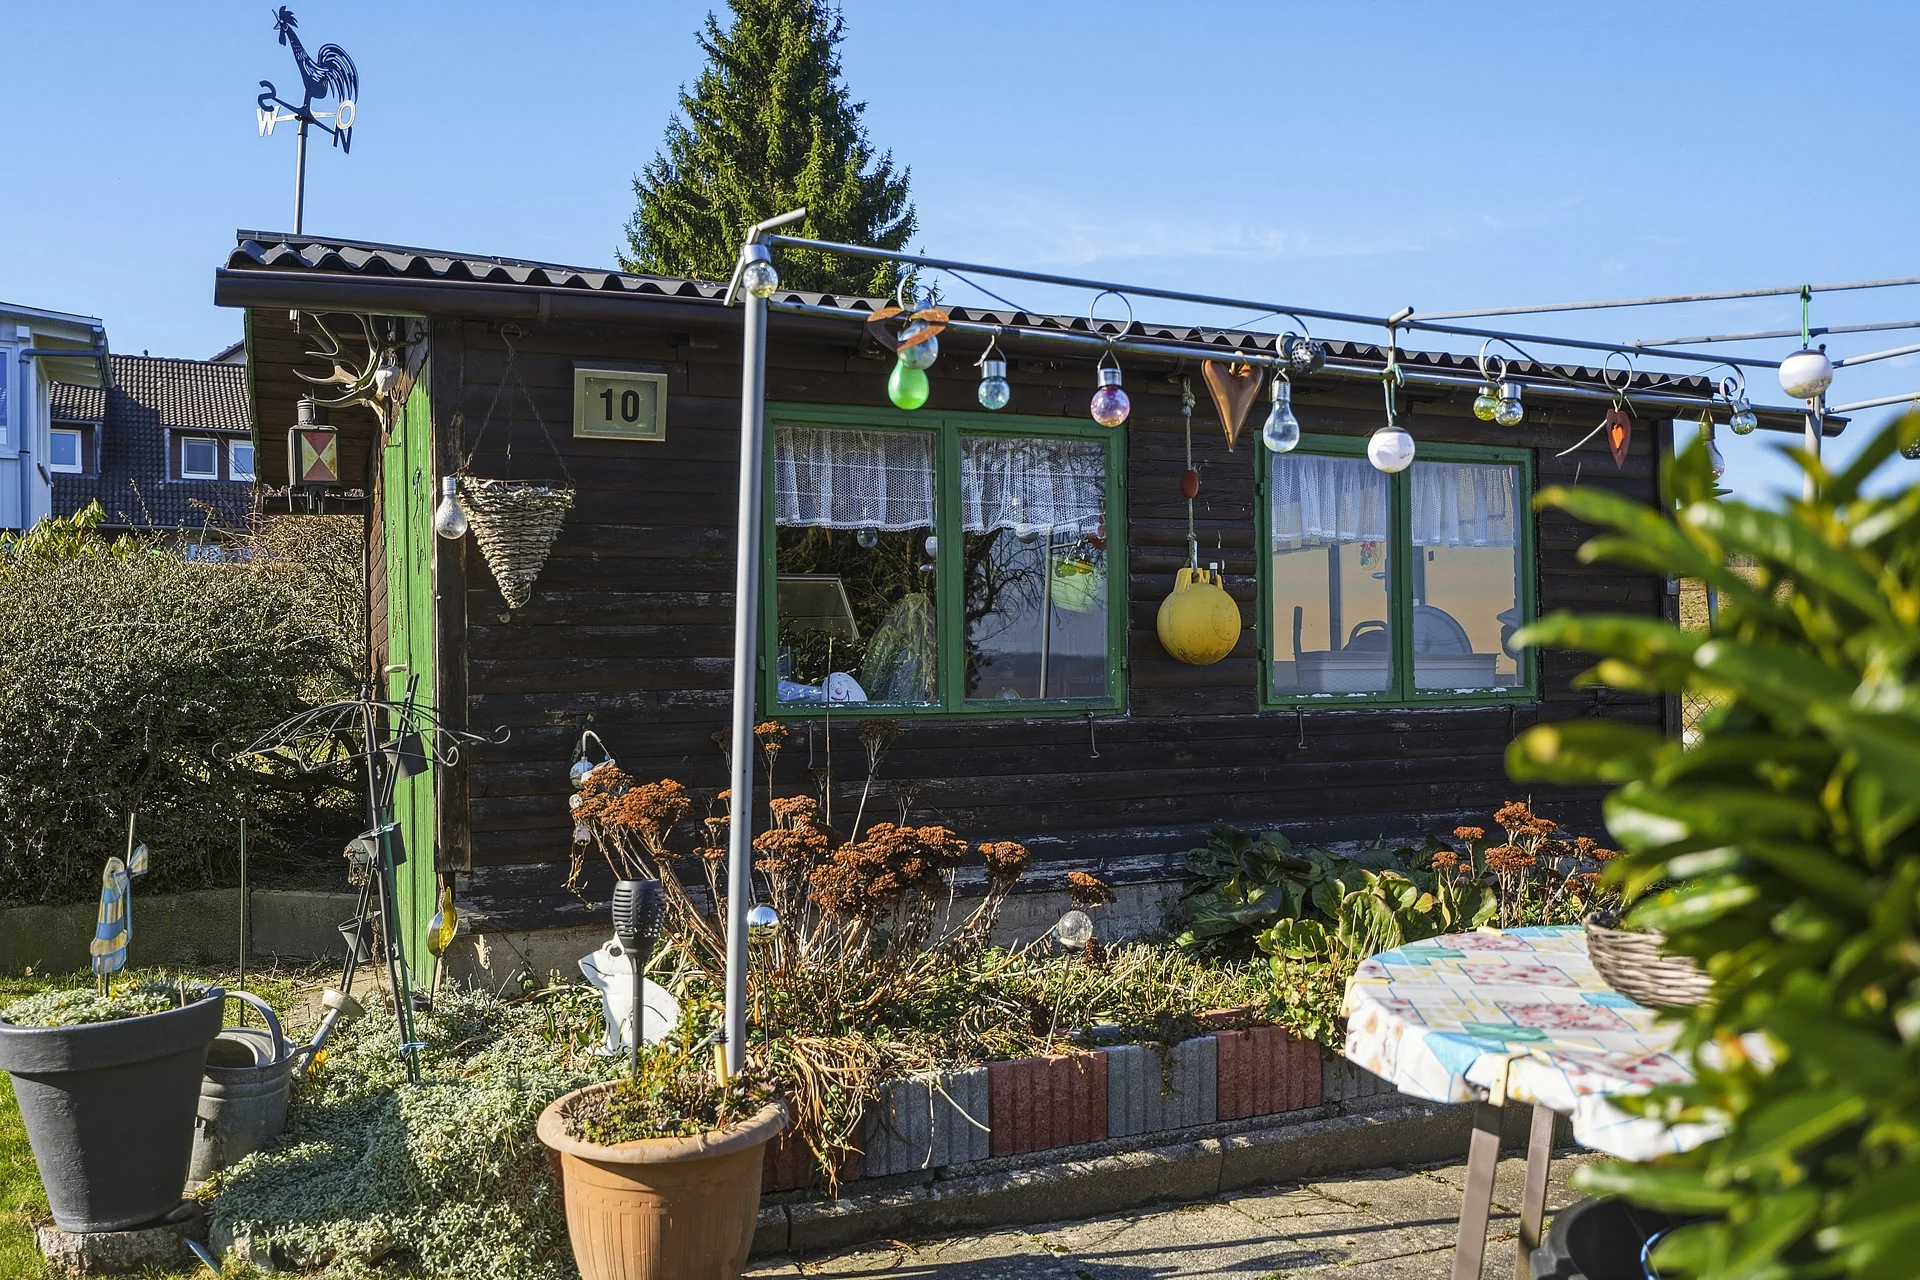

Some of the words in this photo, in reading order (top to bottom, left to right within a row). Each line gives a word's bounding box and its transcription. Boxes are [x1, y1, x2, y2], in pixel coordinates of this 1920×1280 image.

[256, 105, 281, 137] W
[336, 100, 356, 130] O
[332, 119, 353, 154] N
[600, 388, 640, 423] 10
